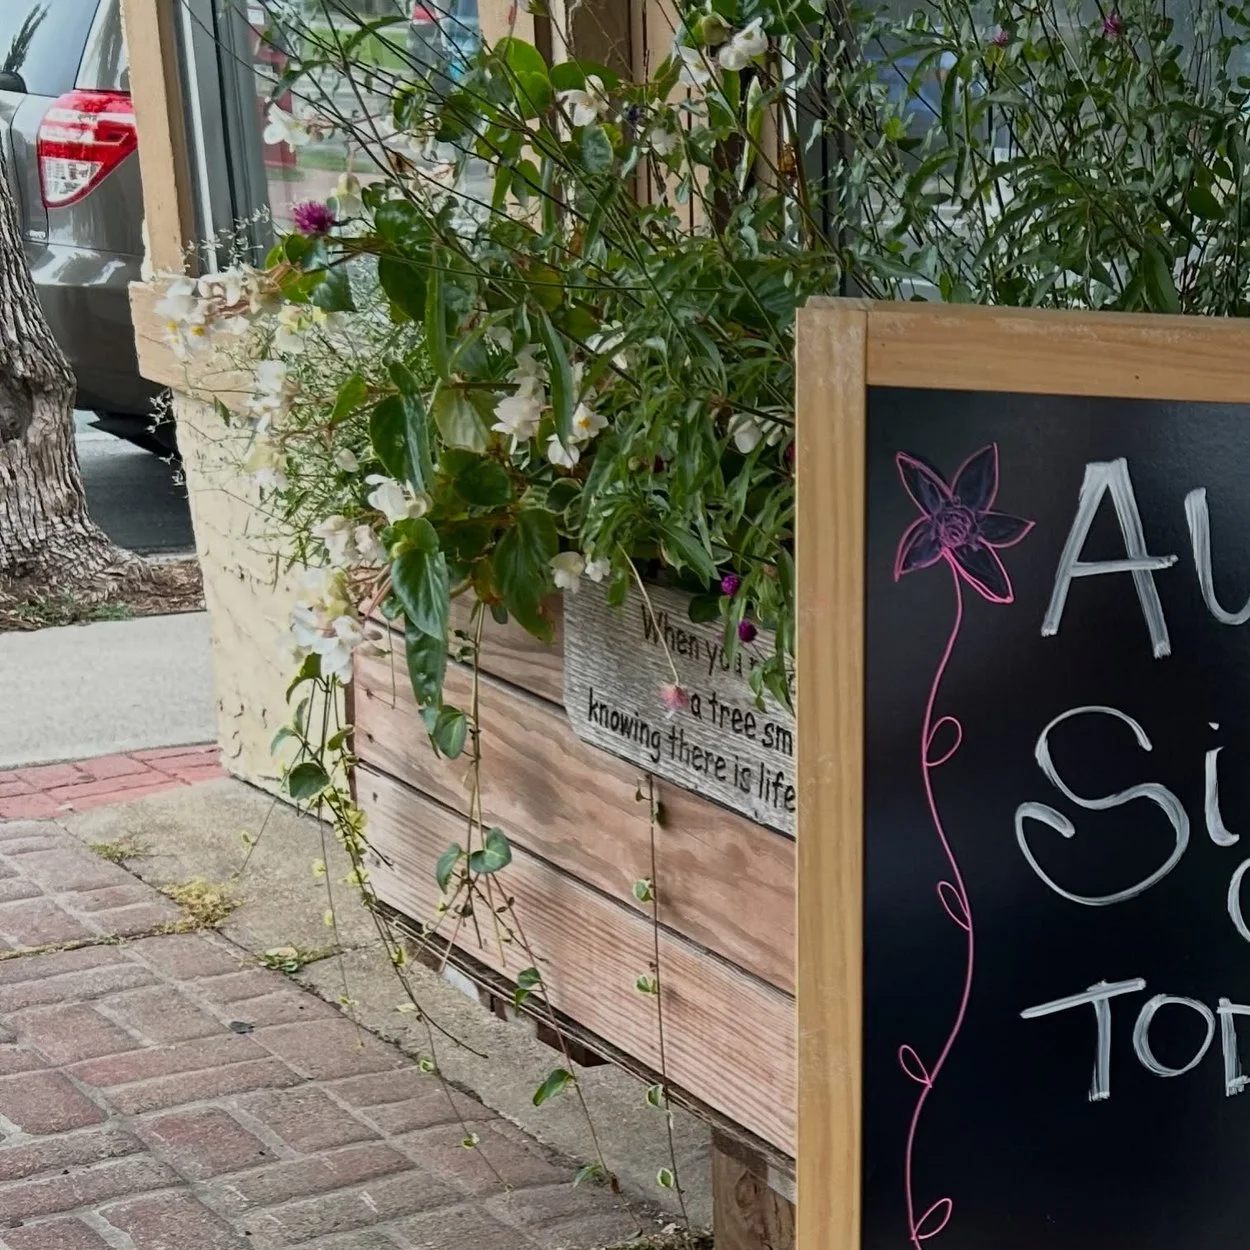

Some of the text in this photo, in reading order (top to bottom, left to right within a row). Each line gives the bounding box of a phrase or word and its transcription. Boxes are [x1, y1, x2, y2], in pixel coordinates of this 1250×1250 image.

[641, 604, 699, 660] When
[691, 693, 702, 720] a
[709, 691, 756, 740] tree
[587, 687, 796, 812] knowing there is life
